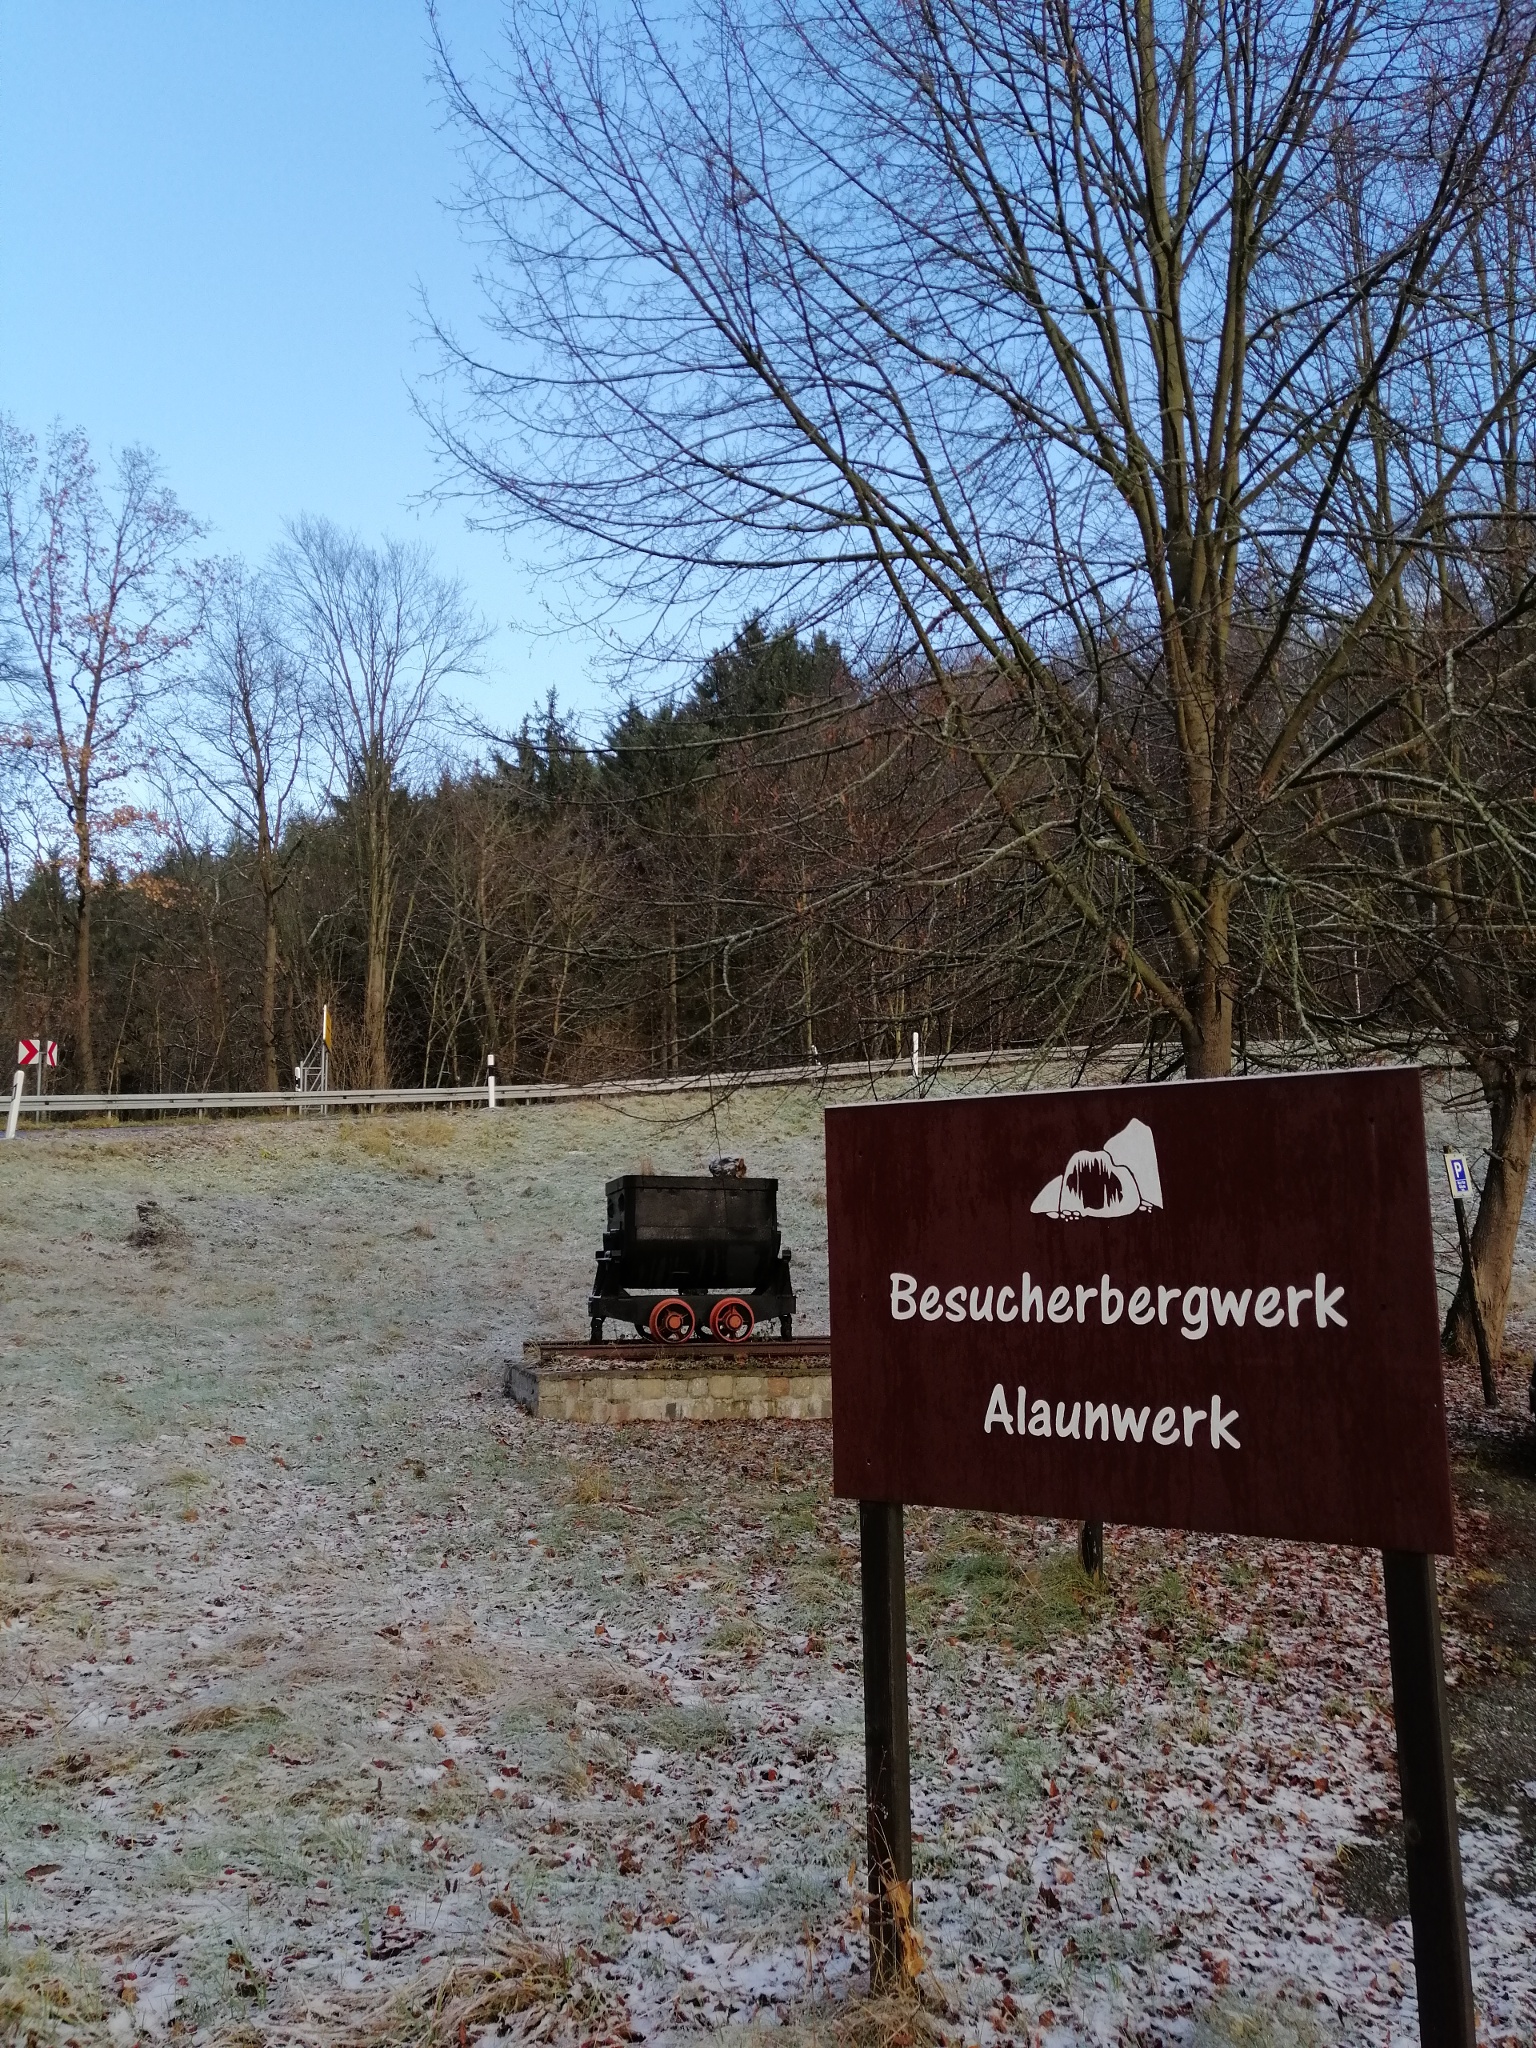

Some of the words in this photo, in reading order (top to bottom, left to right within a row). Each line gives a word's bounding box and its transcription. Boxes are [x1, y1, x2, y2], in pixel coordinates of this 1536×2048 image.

[1453, 1161, 1462, 1178] P
[889, 1271, 1348, 1340] Besucherbergwerk
[983, 1383, 1241, 1450] Alaunwerk
